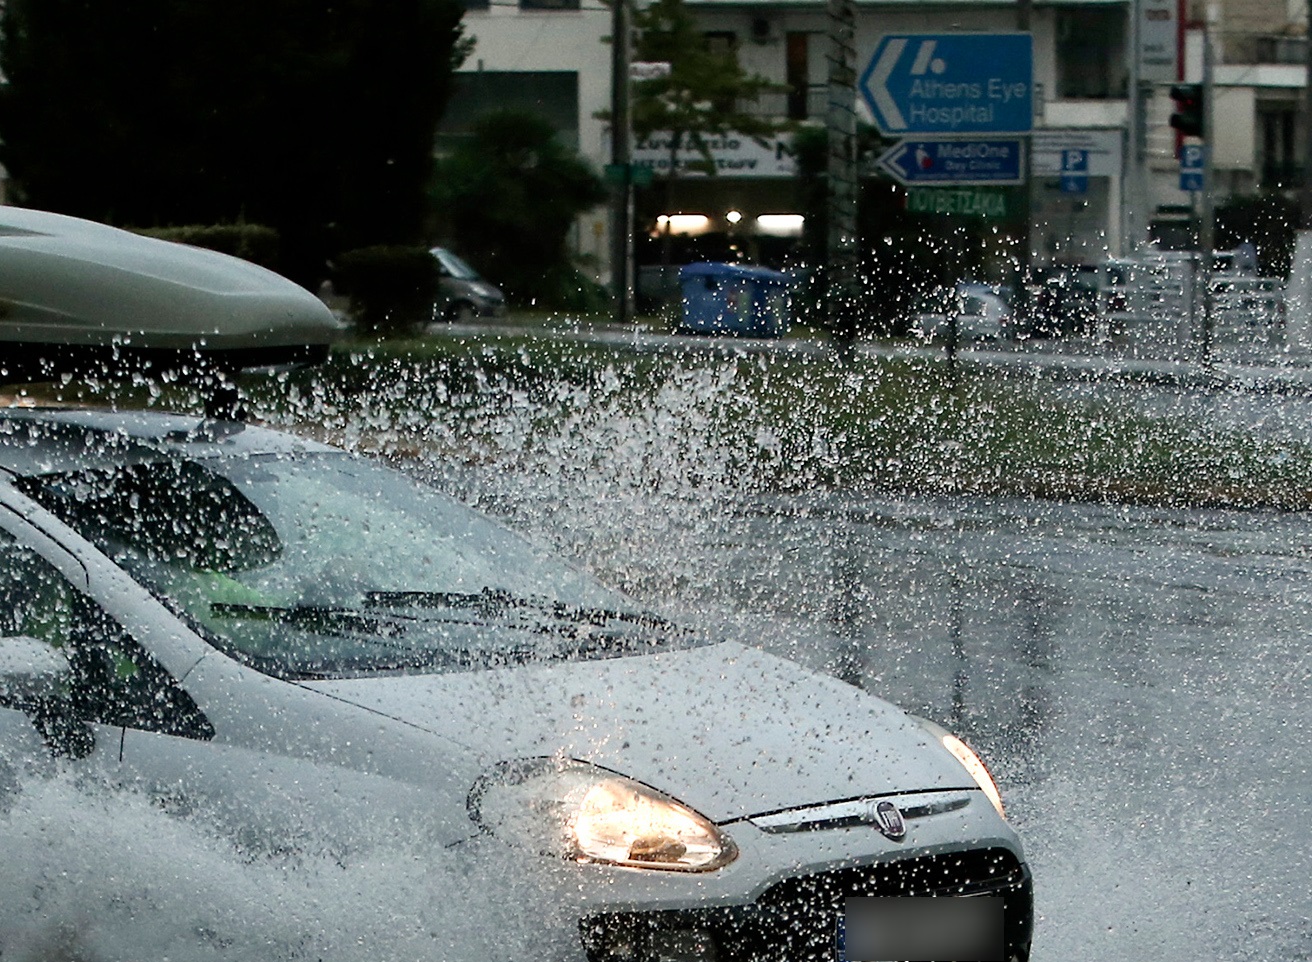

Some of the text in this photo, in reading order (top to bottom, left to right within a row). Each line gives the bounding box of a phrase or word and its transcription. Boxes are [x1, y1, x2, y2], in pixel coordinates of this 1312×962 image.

[909, 78, 1028, 104] Athens Eye
[909, 103, 995, 129] Hospital
[1066, 151, 1082, 170] P
